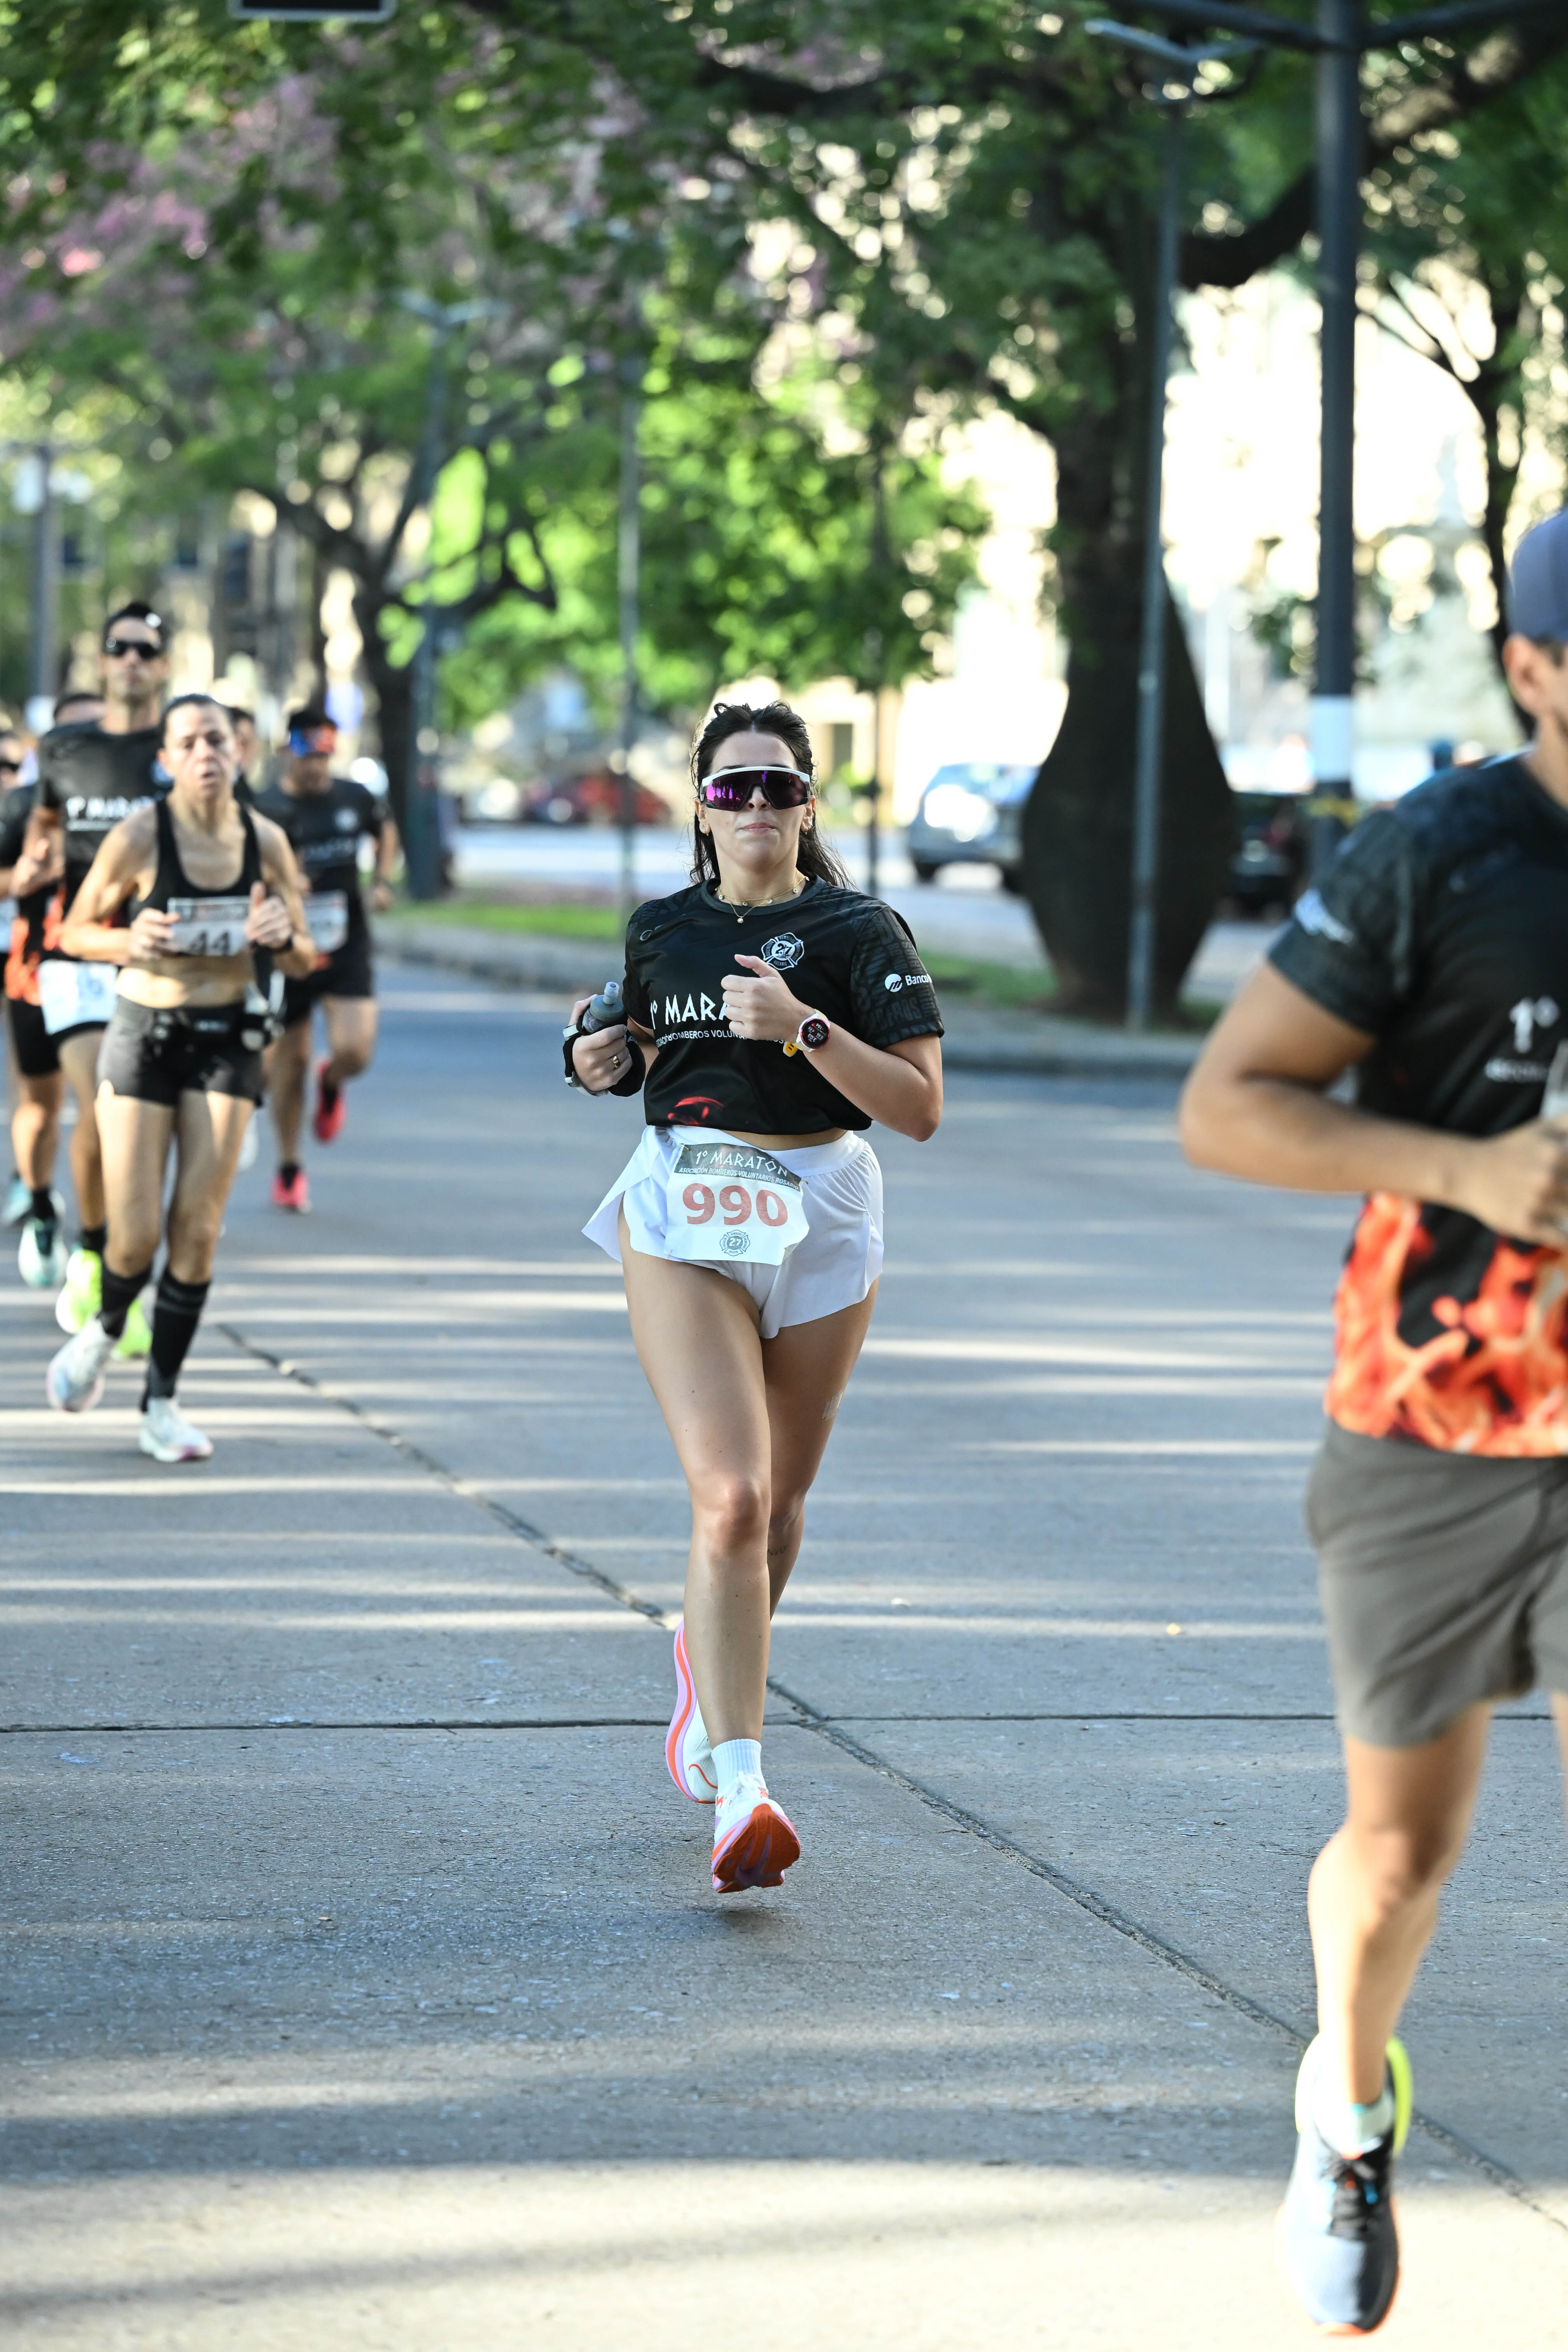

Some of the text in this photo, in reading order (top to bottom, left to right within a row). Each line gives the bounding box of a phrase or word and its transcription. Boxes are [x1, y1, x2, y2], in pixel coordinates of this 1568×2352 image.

[775, 943, 793, 954] 27
[665, 992, 730, 1025] MARA
[710, 1151, 787, 1176] MARATÓN
[709, 1168, 737, 1176] BOMBEROS
[739, 1170, 775, 1182] VOLUNTARIOS
[775, 1177, 799, 1190] ROSARIO
[682, 1183, 788, 1227] 990
[729, 1237, 742, 1247] 27
